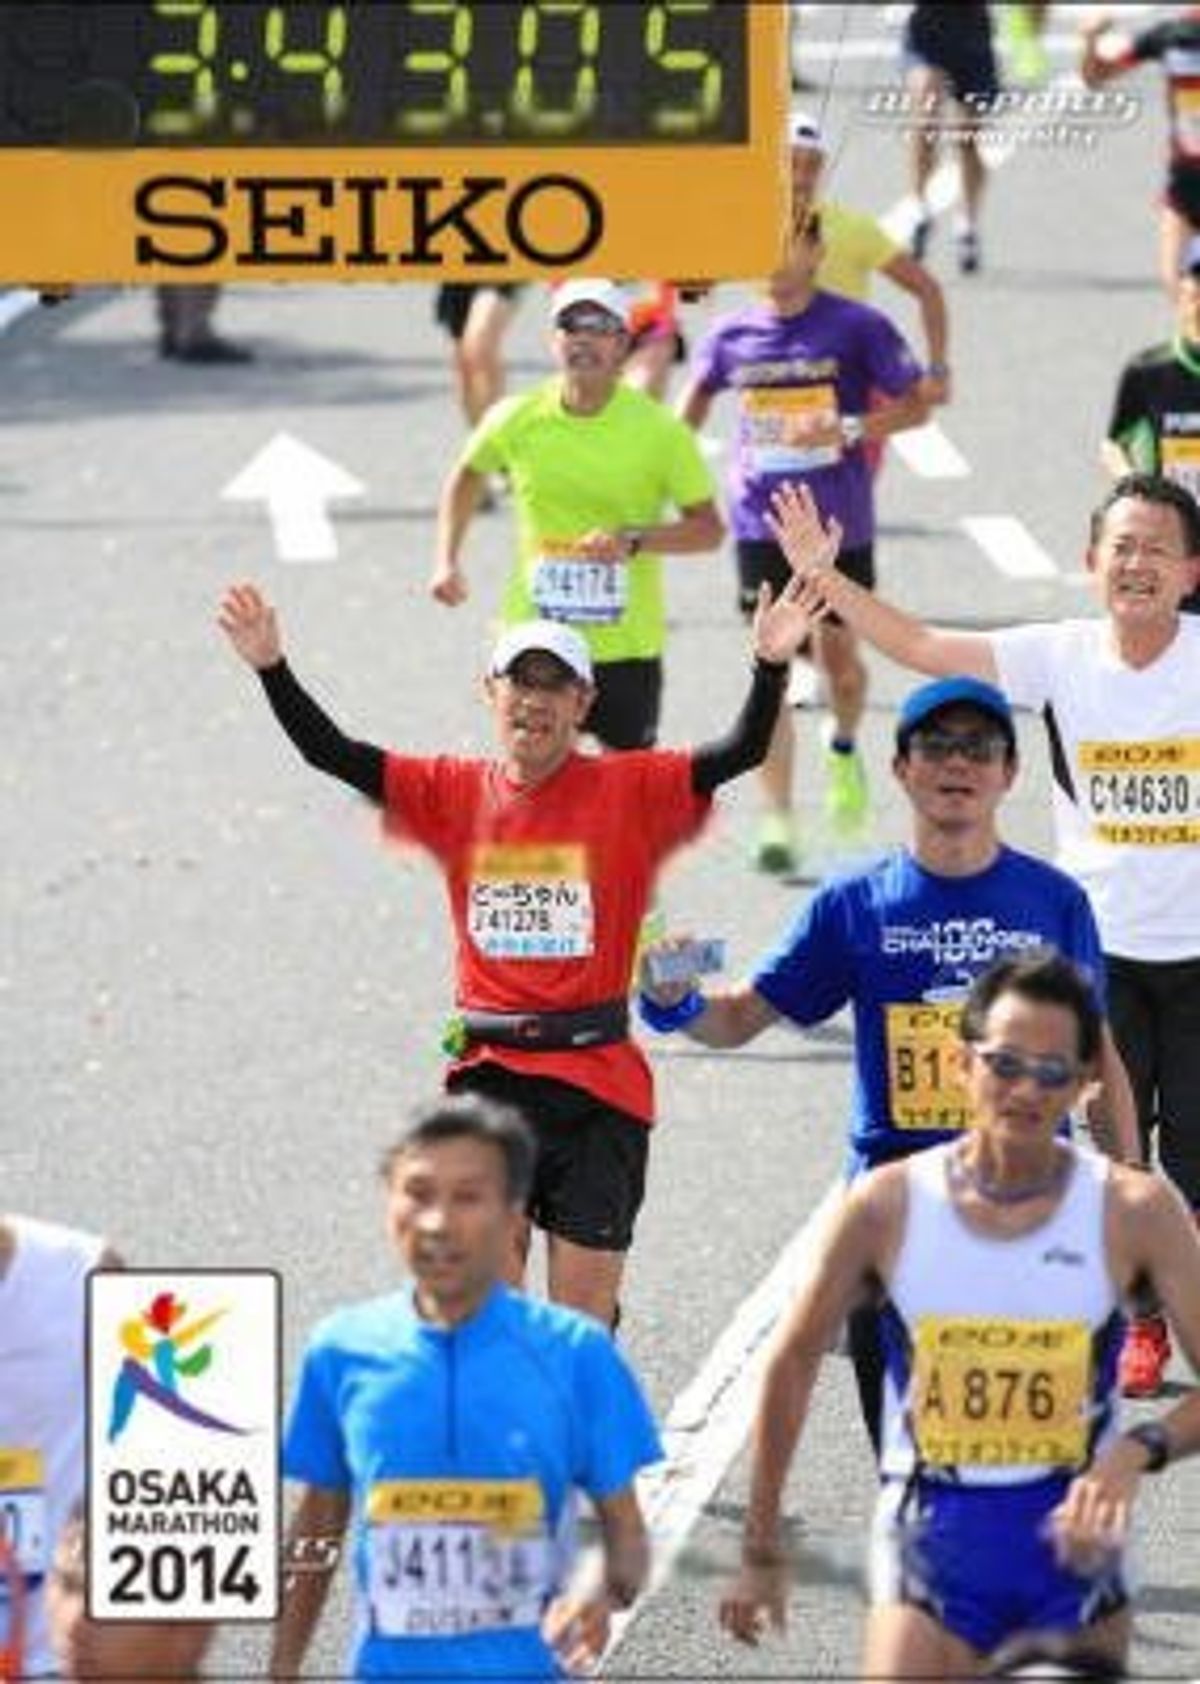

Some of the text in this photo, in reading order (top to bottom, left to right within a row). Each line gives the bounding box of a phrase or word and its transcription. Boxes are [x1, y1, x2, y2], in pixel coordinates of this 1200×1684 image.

[134, 175, 604, 266] SEIKO
[1090, 774, 1189, 814] C14630
[473, 881, 579, 907] とーちゃん
[923, 1368, 1055, 1420] A 876
